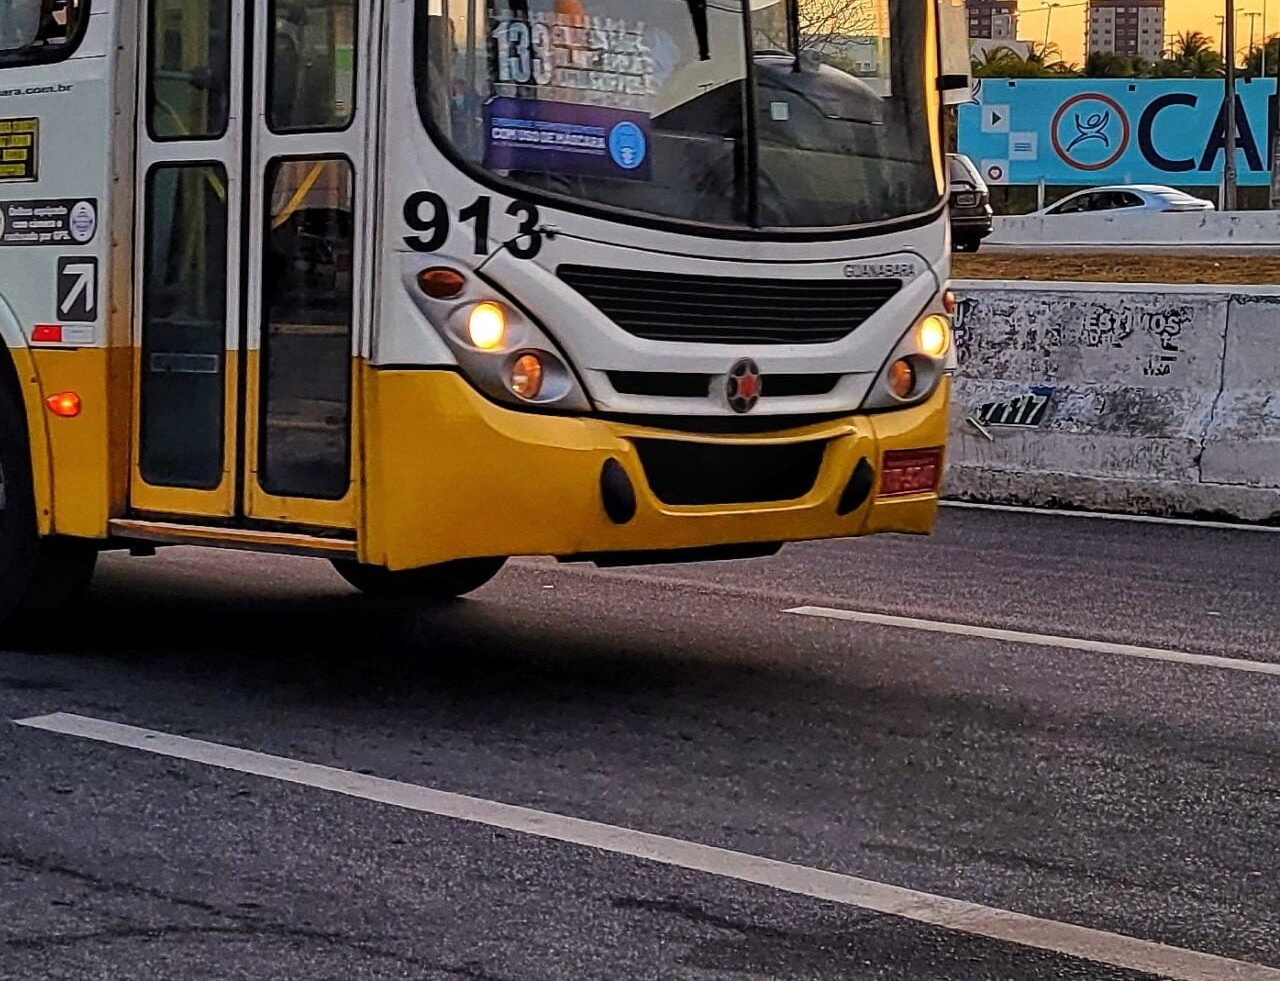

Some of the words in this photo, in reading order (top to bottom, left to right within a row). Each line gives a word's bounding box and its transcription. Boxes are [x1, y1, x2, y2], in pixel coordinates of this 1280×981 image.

[492, 22, 552, 85] 133
[403, 190, 542, 260] 913
[843, 264, 915, 278] GUANABARA
